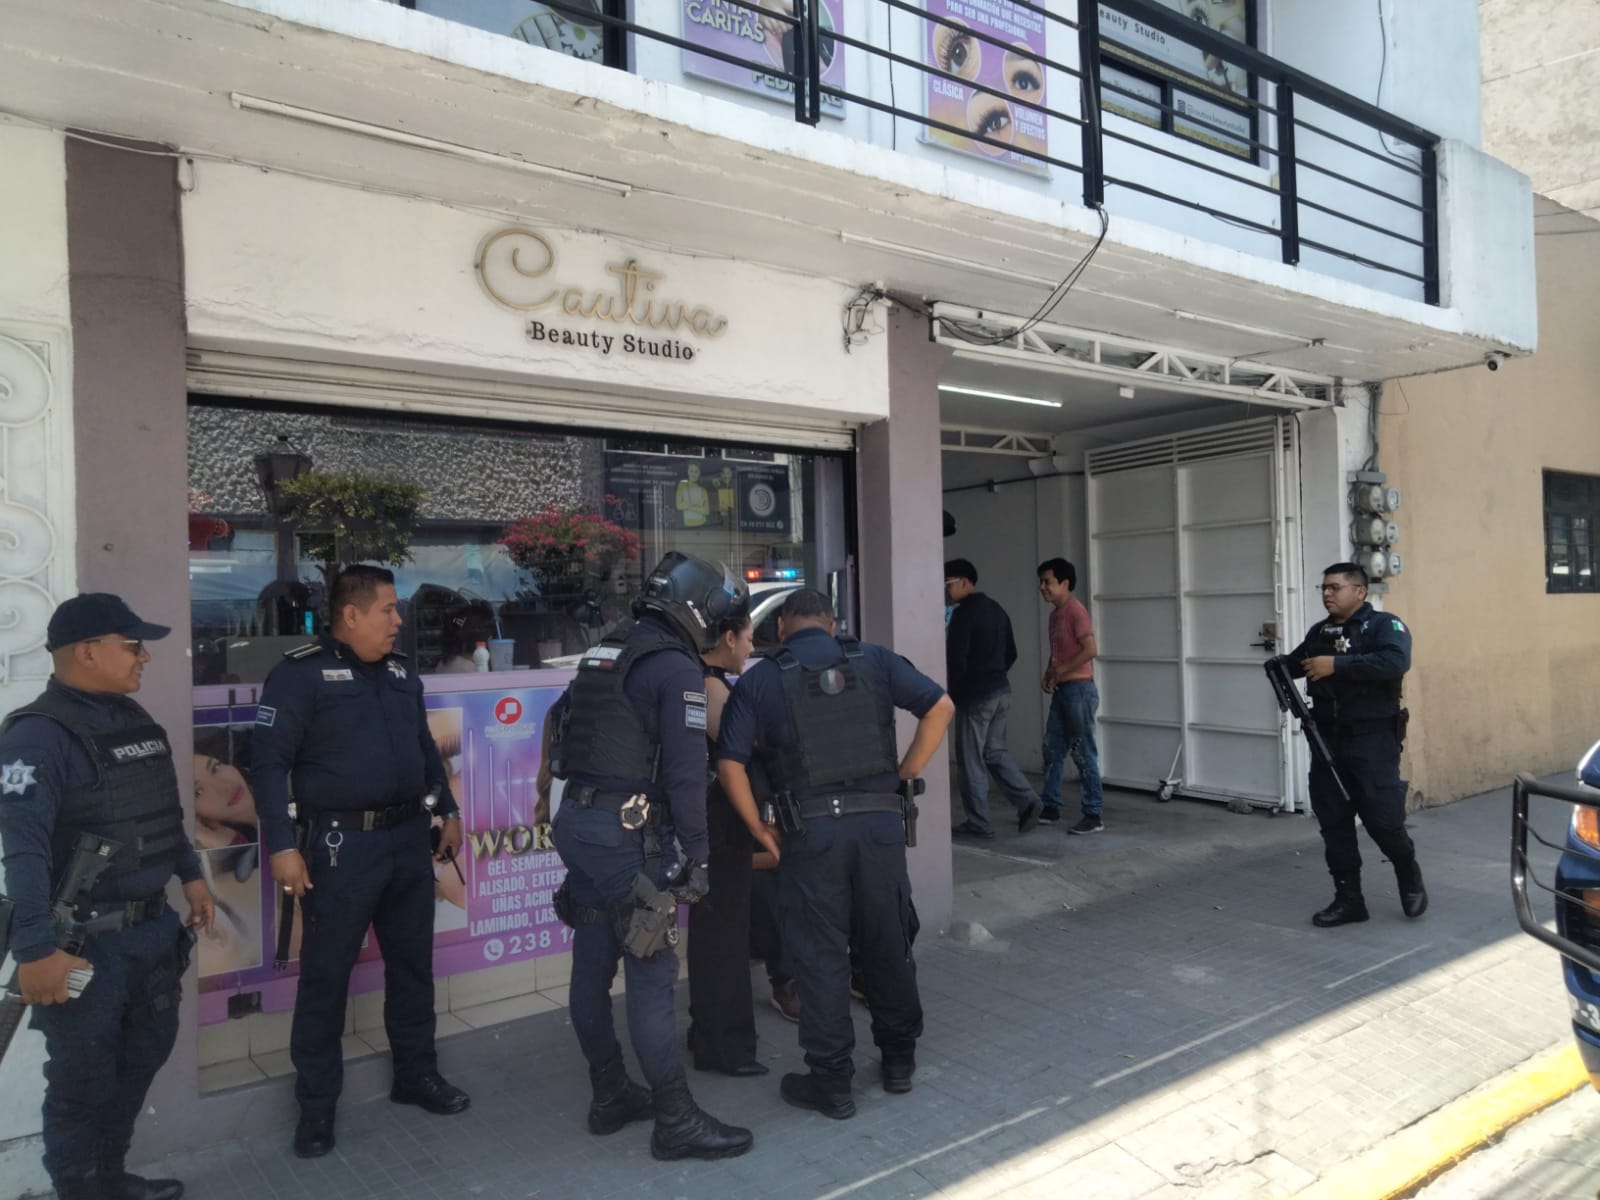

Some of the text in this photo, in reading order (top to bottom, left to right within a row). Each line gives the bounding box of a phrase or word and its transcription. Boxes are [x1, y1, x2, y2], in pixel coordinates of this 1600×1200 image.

[687, 2, 765, 43] CARITAS
[1099, 9, 1166, 44] eauty Studio
[752, 60, 843, 107] PEDIRE
[933, 80, 964, 101] CLÁSICA
[480, 228, 728, 337] Cautiva
[530, 321, 694, 360] Beauty Studio
[466, 822, 556, 860] WOR
[488, 860, 507, 876] GEL
[480, 876, 529, 896] ALISADO,
[492, 888, 554, 914] UÑAS ACRIL
[509, 930, 552, 955] 238
